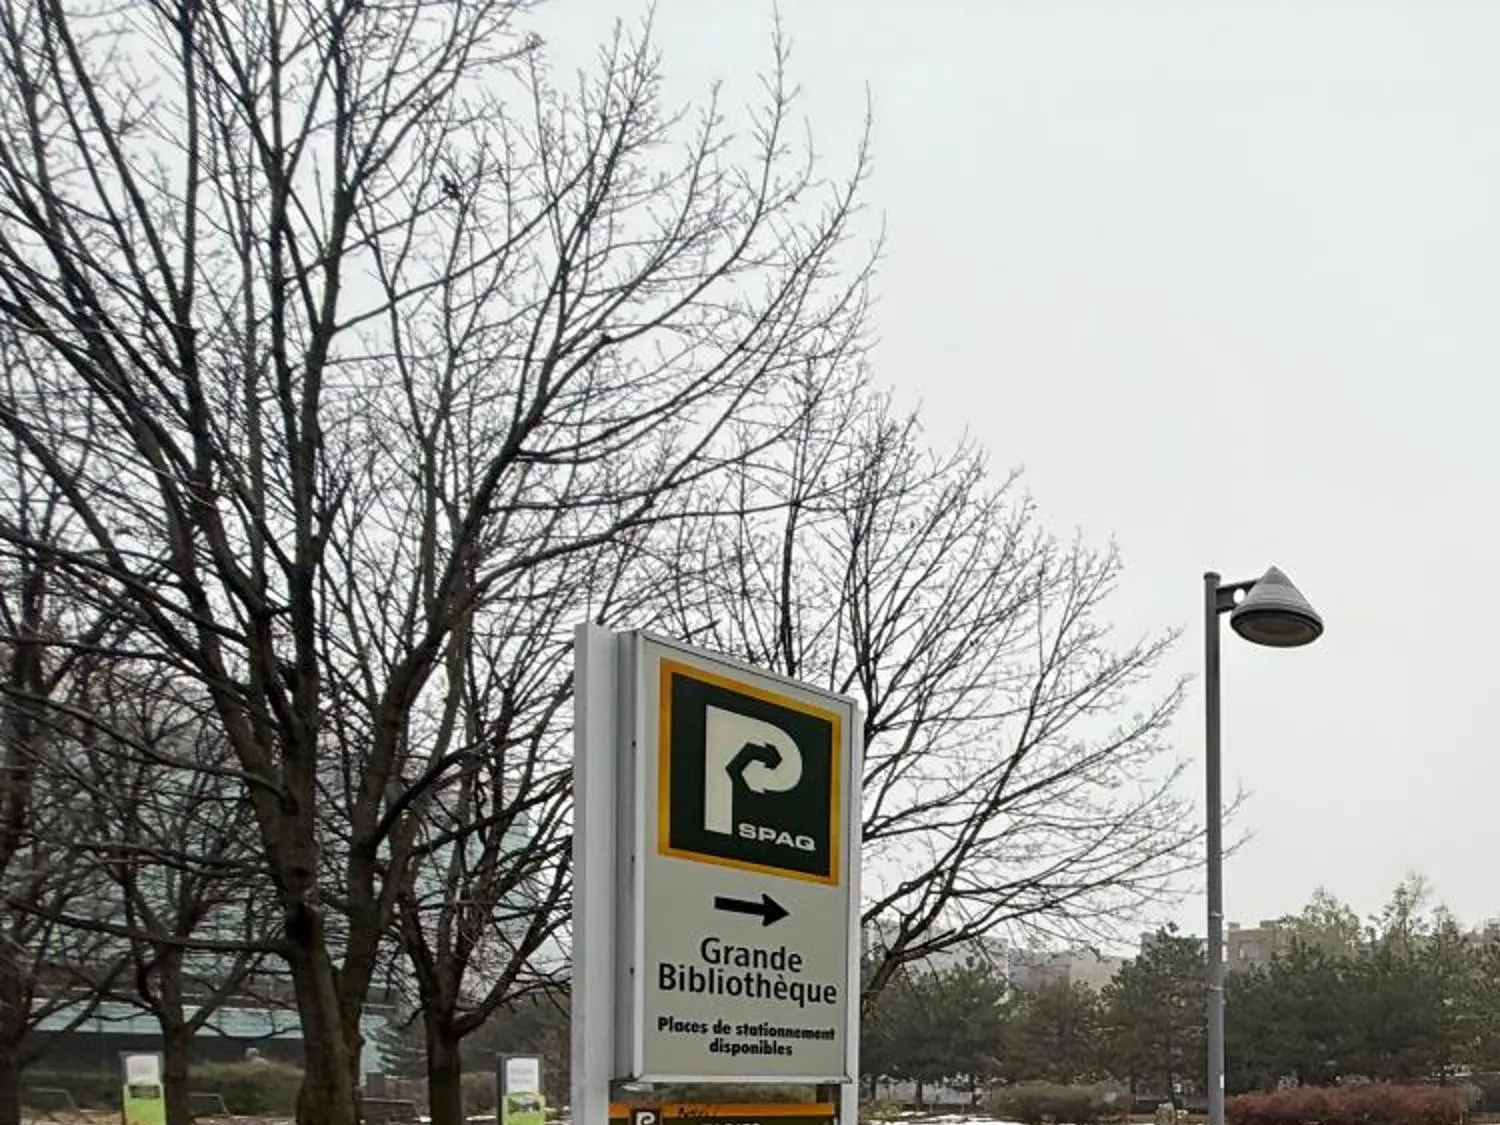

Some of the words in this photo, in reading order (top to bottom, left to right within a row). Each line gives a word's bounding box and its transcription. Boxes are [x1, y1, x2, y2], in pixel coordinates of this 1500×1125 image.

[738, 824, 816, 851] SPAQ
[701, 937, 802, 973] Grande
[659, 963, 837, 1008] Bibliothèque
[657, 1016, 708, 1033] Places
[713, 1020, 731, 1035] de
[736, 1023, 835, 1040] stationnement
[709, 1039, 792, 1056] disponibles
